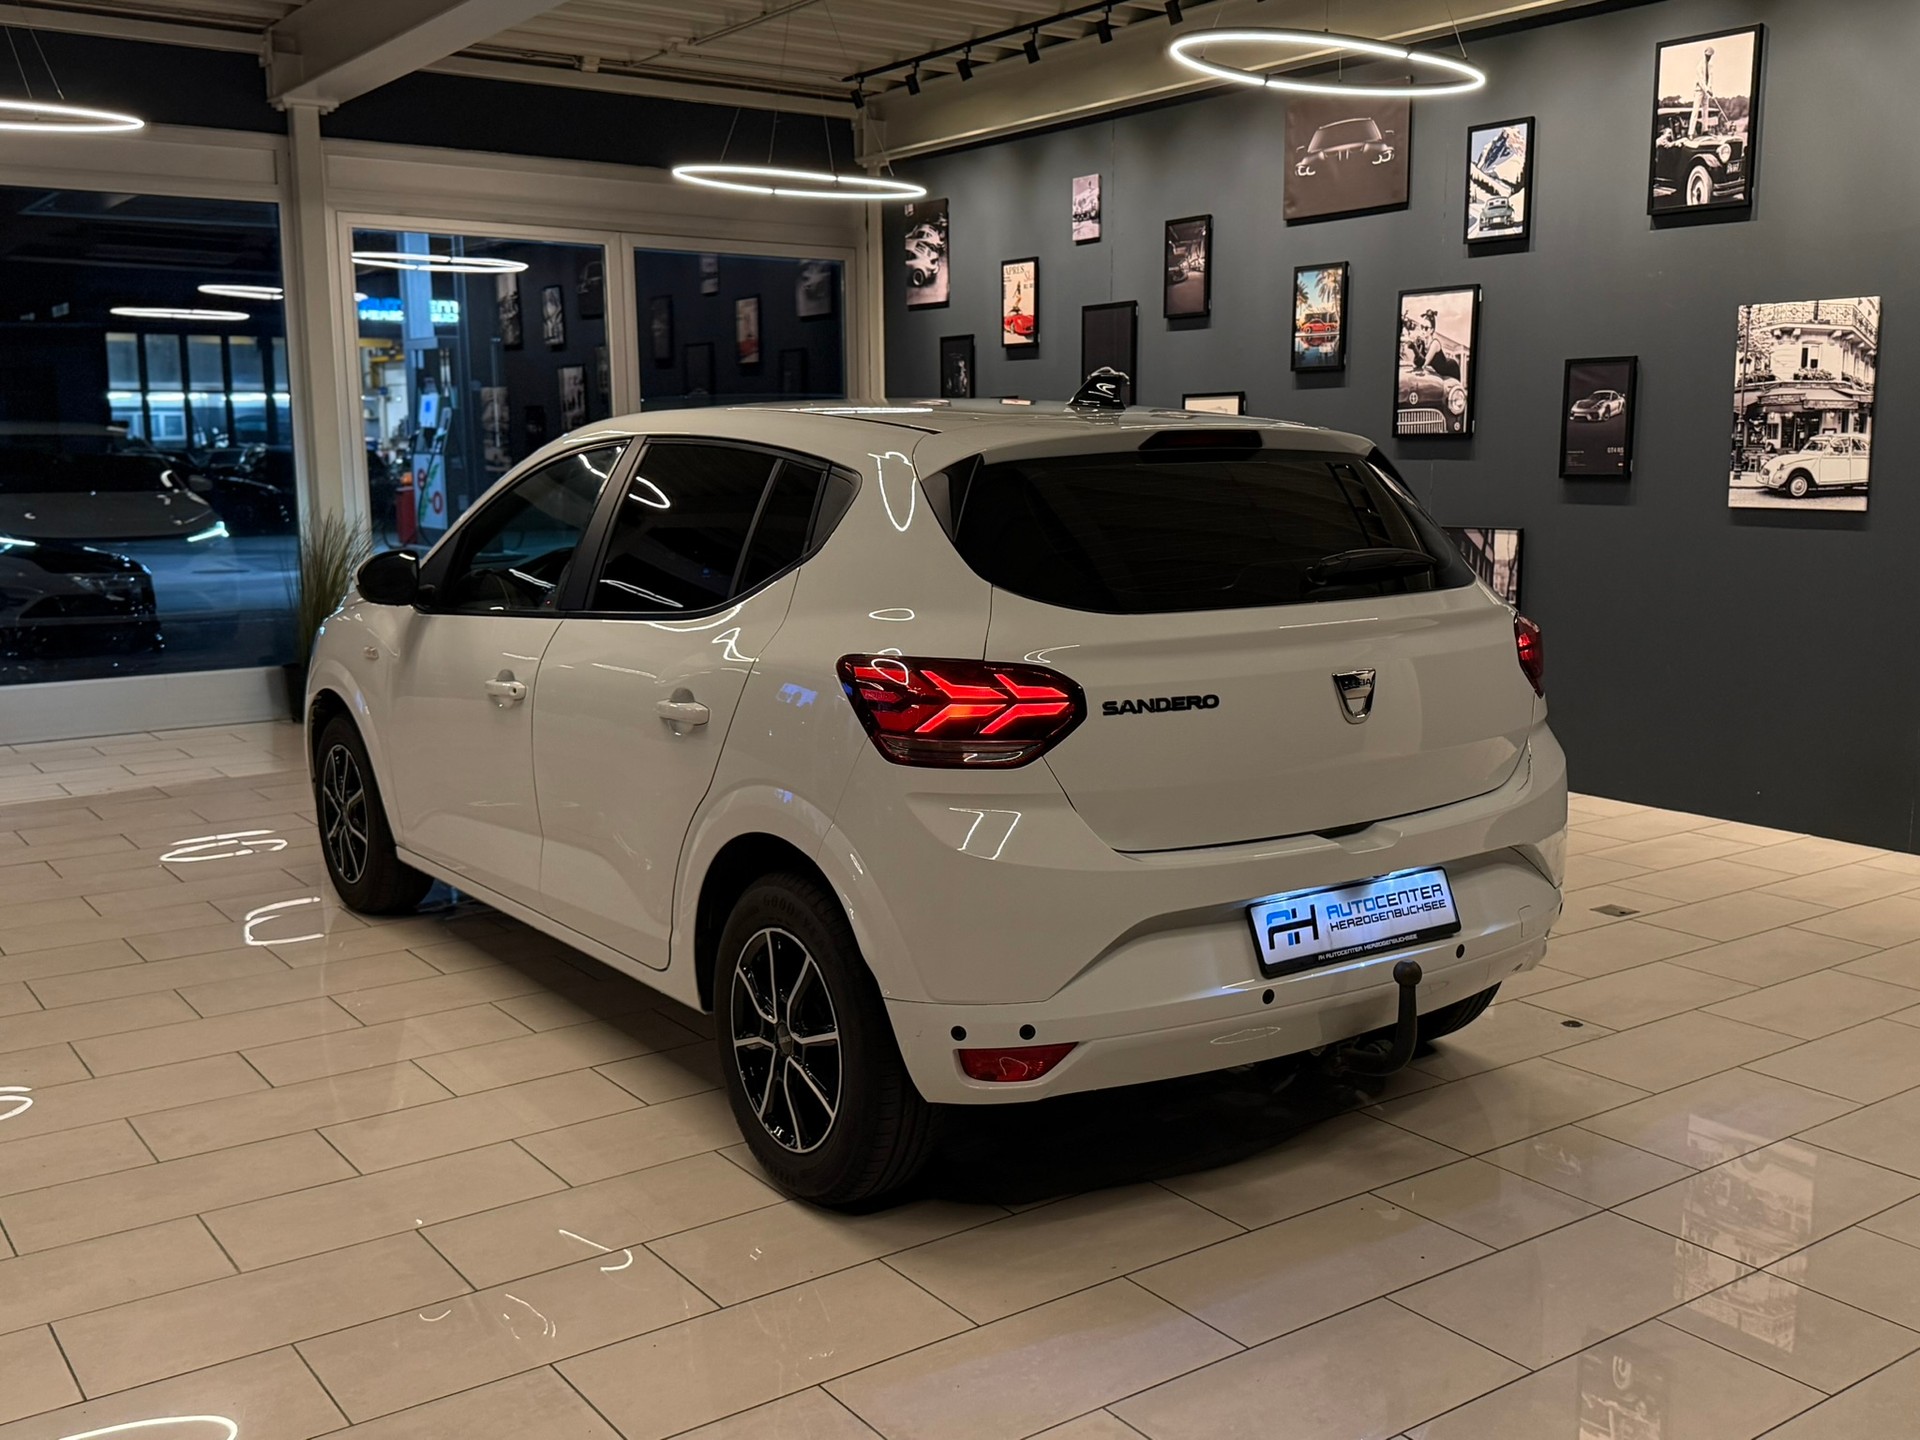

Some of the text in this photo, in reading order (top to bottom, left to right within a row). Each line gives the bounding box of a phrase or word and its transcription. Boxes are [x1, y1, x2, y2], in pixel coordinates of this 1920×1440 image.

[1102, 694, 1220, 716] SANDERO
[1326, 883, 1444, 920] AUTOCENTER
[1329, 899, 1447, 932] HERZOGENBUCHSEE
[1326, 945, 1363, 960] AUTOCENTER
[1364, 933, 1418, 951] HERZOGENBUCHSEE
